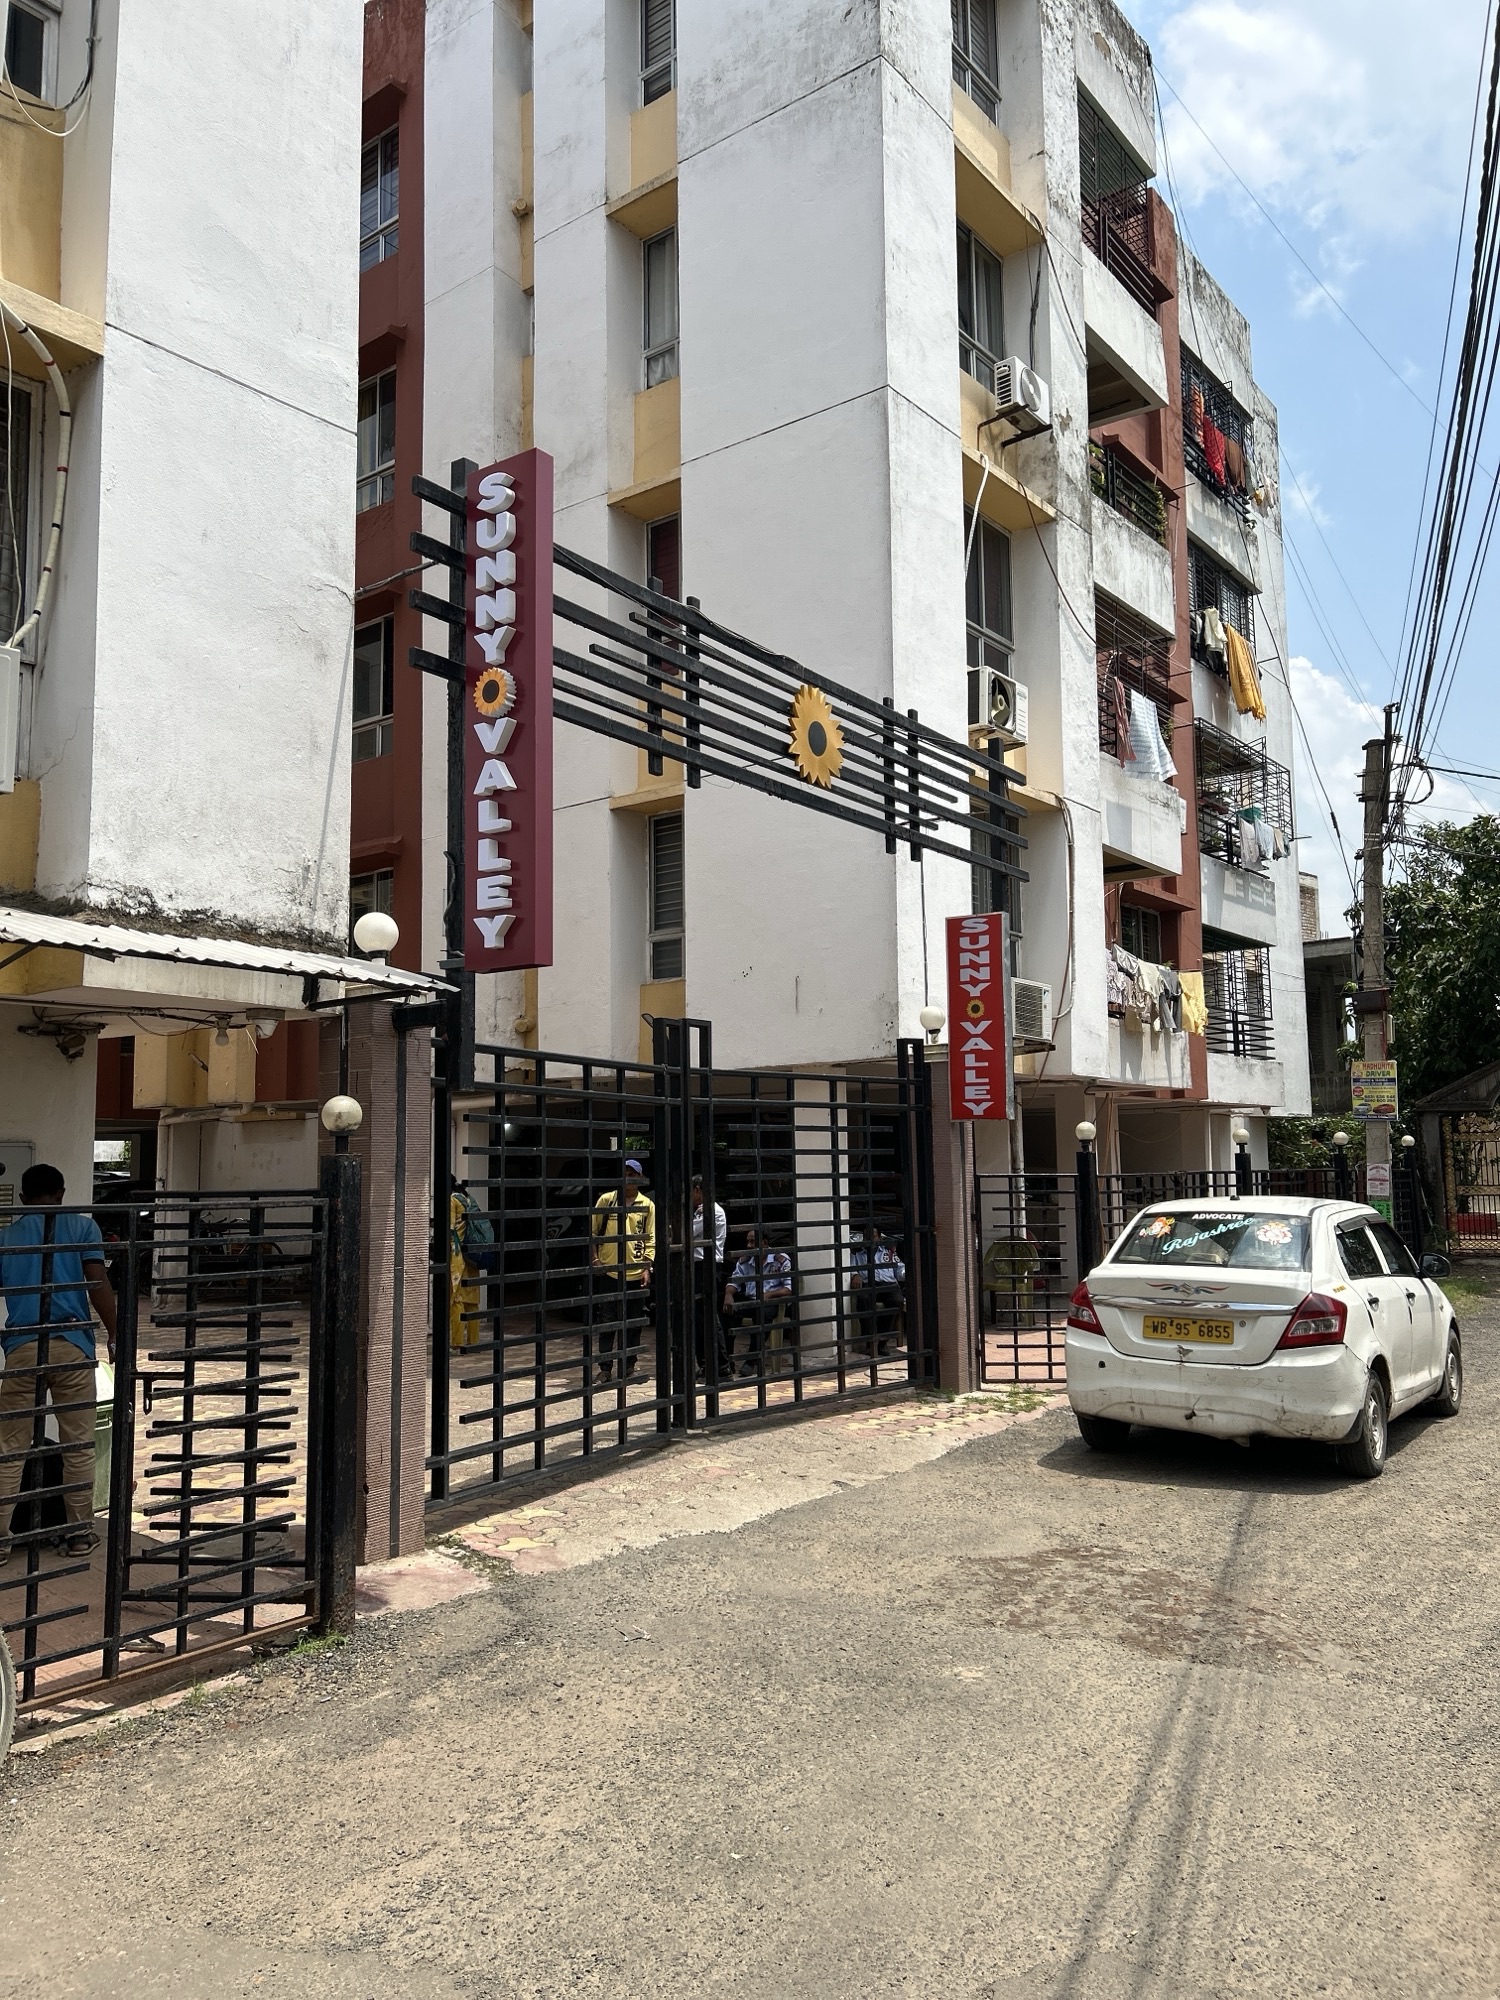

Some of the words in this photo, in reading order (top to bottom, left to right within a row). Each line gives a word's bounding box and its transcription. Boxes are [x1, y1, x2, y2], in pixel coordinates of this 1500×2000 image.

[473, 472, 517, 667] SUNNY
[473, 717, 518, 950] VALLEY
[958, 917, 991, 998] SUNNY
[960, 1020, 994, 1116] VALLEY
[1161, 1217, 1256, 1255] Rajashree
[1152, 1320, 1167, 1335] WB
[1175, 1322, 1190, 1336] 95
[1198, 1324, 1230, 1339] 6855
